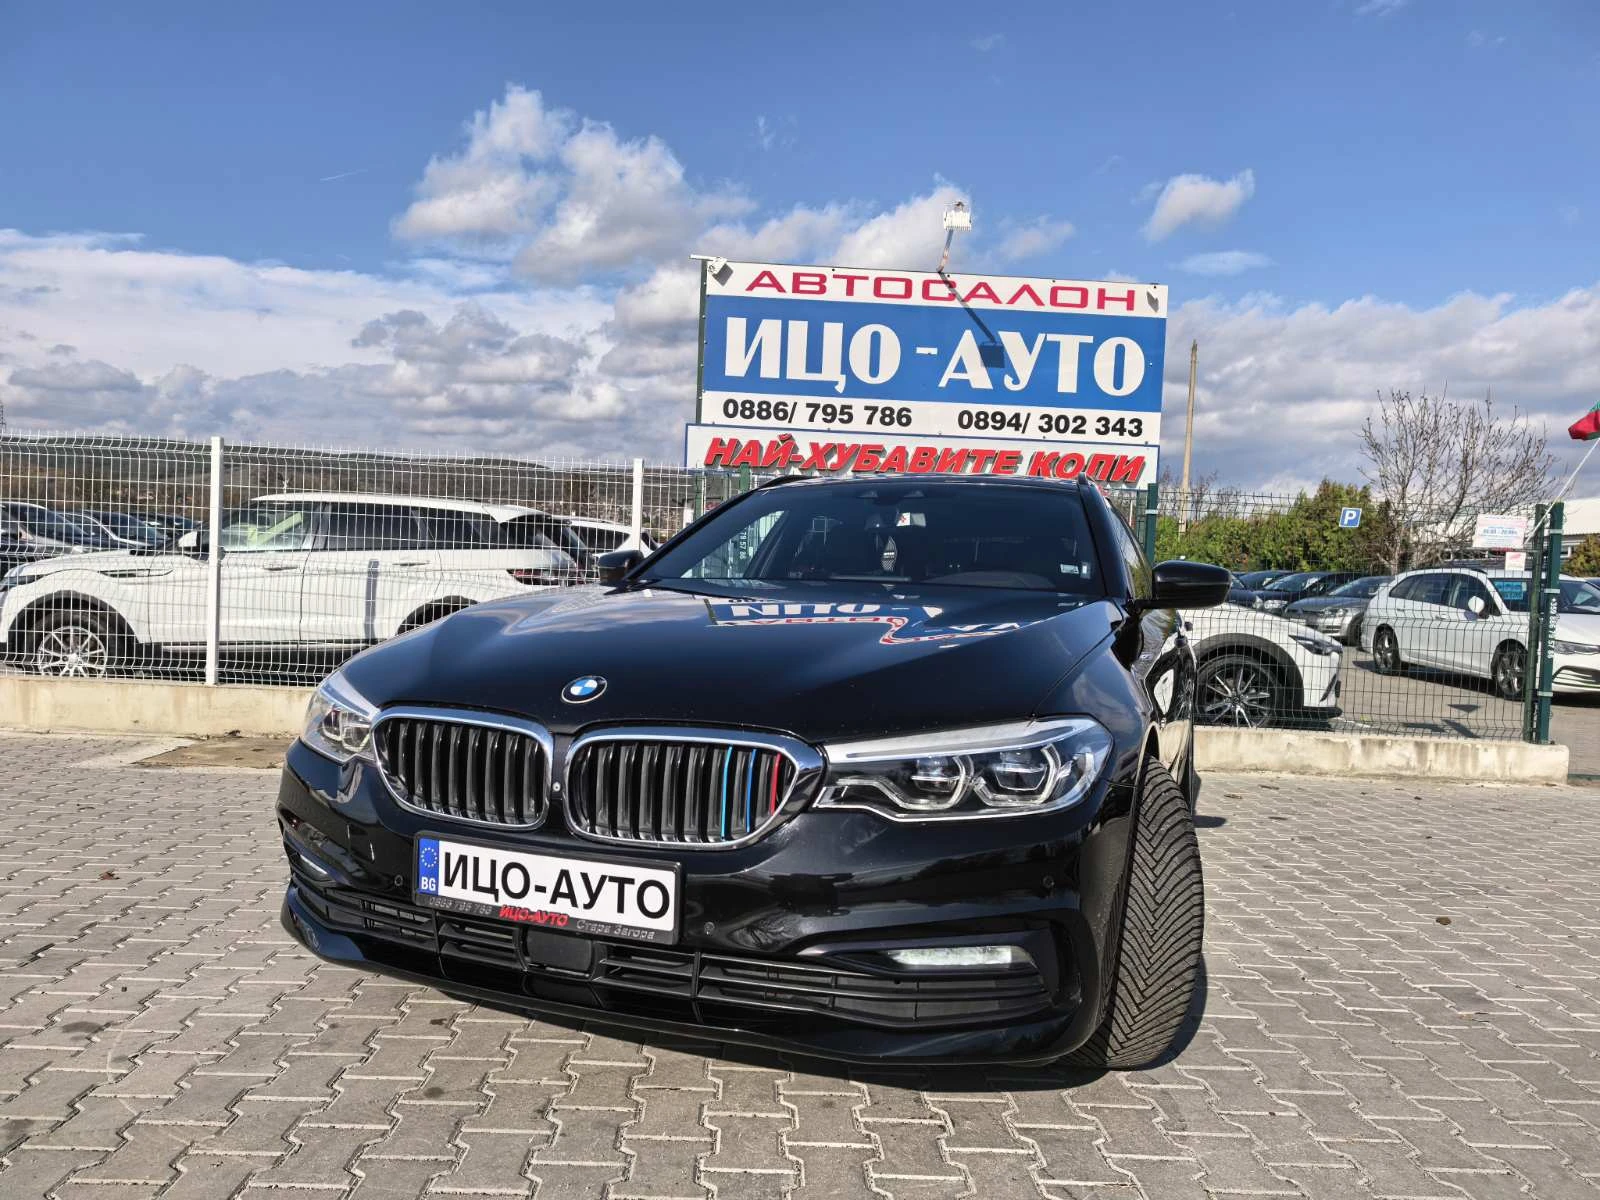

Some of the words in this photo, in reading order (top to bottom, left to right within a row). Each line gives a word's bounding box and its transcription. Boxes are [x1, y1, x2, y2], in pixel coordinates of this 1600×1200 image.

[745, 270, 1135, 311] АВТОСАЛОН
[722, 399, 797, 423] 0886/
[806, 402, 854, 425] 795
[863, 406, 913, 428] 786
[957, 409, 1031, 434] 0894/
[1038, 413, 1086, 436] 302
[1095, 416, 1144, 438] 343
[421, 876, 436, 892] BG
[444, 852, 670, 919] ИЦО-АУТО
[498, 904, 571, 927] ИЦО-АУТО
